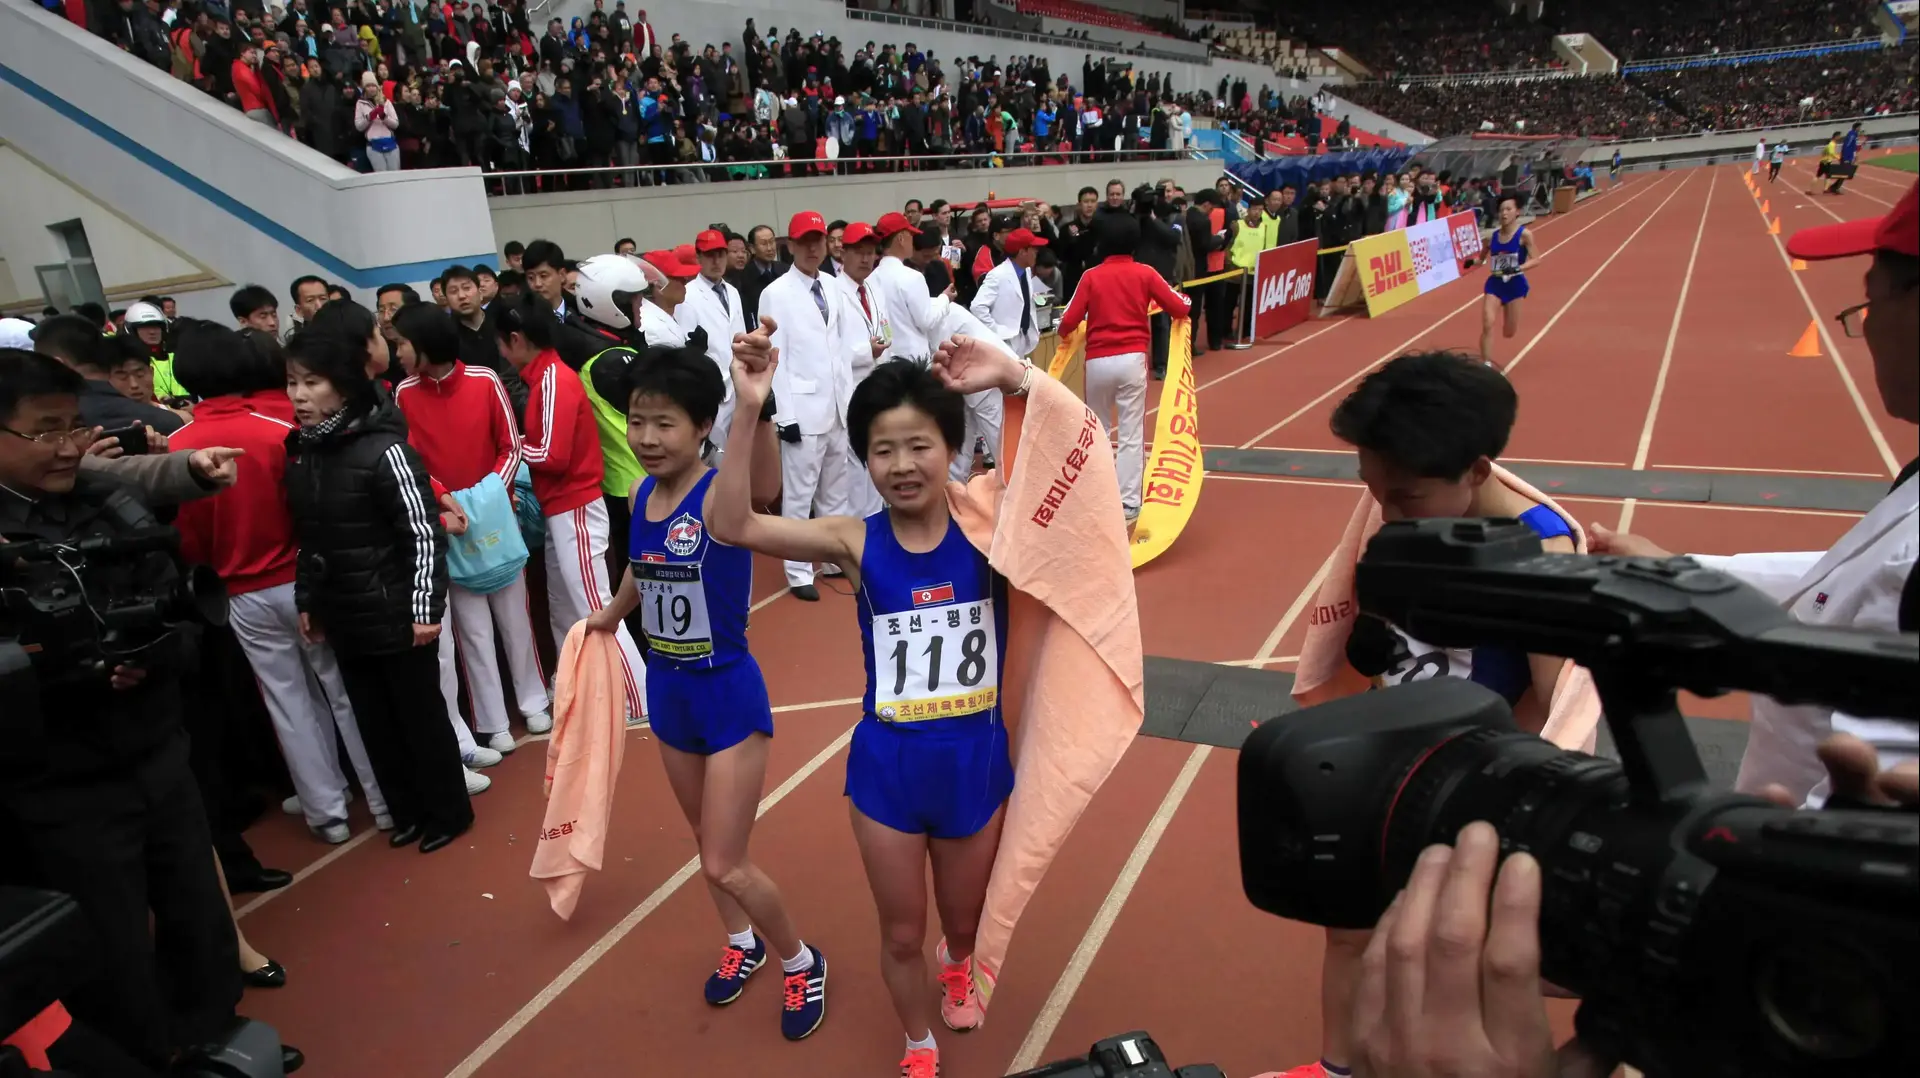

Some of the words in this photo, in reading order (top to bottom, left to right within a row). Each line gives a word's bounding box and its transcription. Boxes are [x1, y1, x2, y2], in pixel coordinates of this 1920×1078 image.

[1259, 268, 1312, 314] IAAF.ORG
[1369, 250, 1408, 295] DHL
[888, 628, 987, 696] 118
[540, 819, 578, 841] 손경
